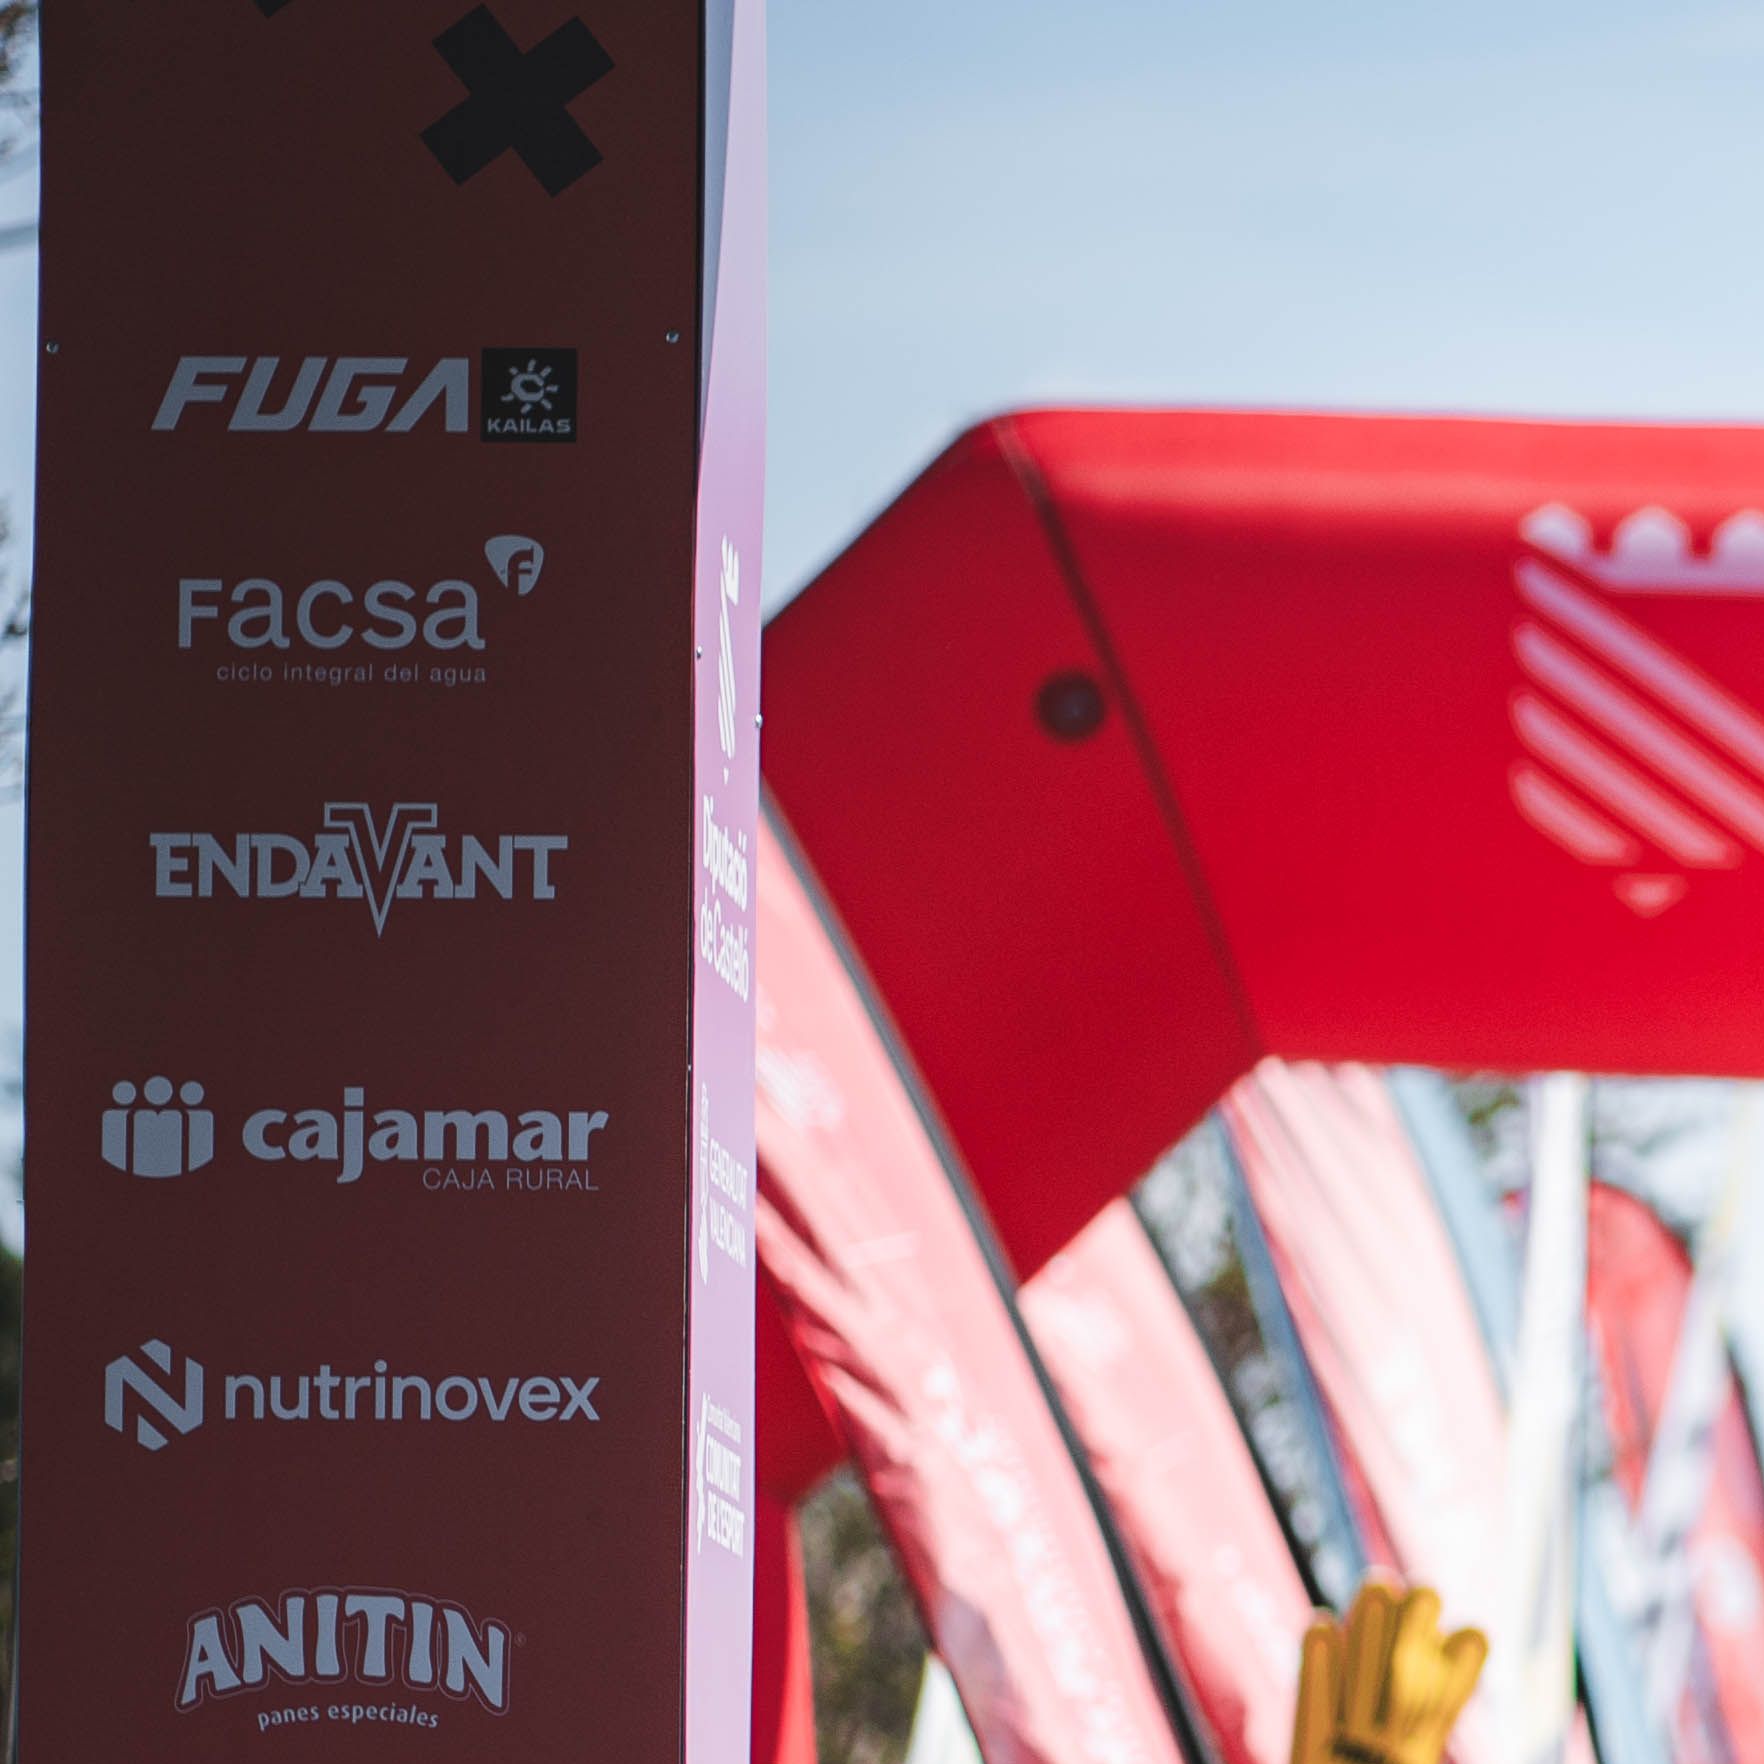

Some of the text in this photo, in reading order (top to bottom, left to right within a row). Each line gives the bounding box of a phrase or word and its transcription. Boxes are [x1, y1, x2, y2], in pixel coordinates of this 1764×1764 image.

[151, 357, 571, 433] FUGA KAILAS
[216, 663, 487, 686] ciclo integral del agua
[149, 803, 568, 937] ENDAVANT
[242, 1086, 609, 1184] cajamar
[422, 1168, 600, 1191] CAJA RURAL
[225, 1360, 600, 1422] nutrinovex
[176, 1594, 510, 1710] ANITIN
[257, 1702, 439, 1731] panes especiales
